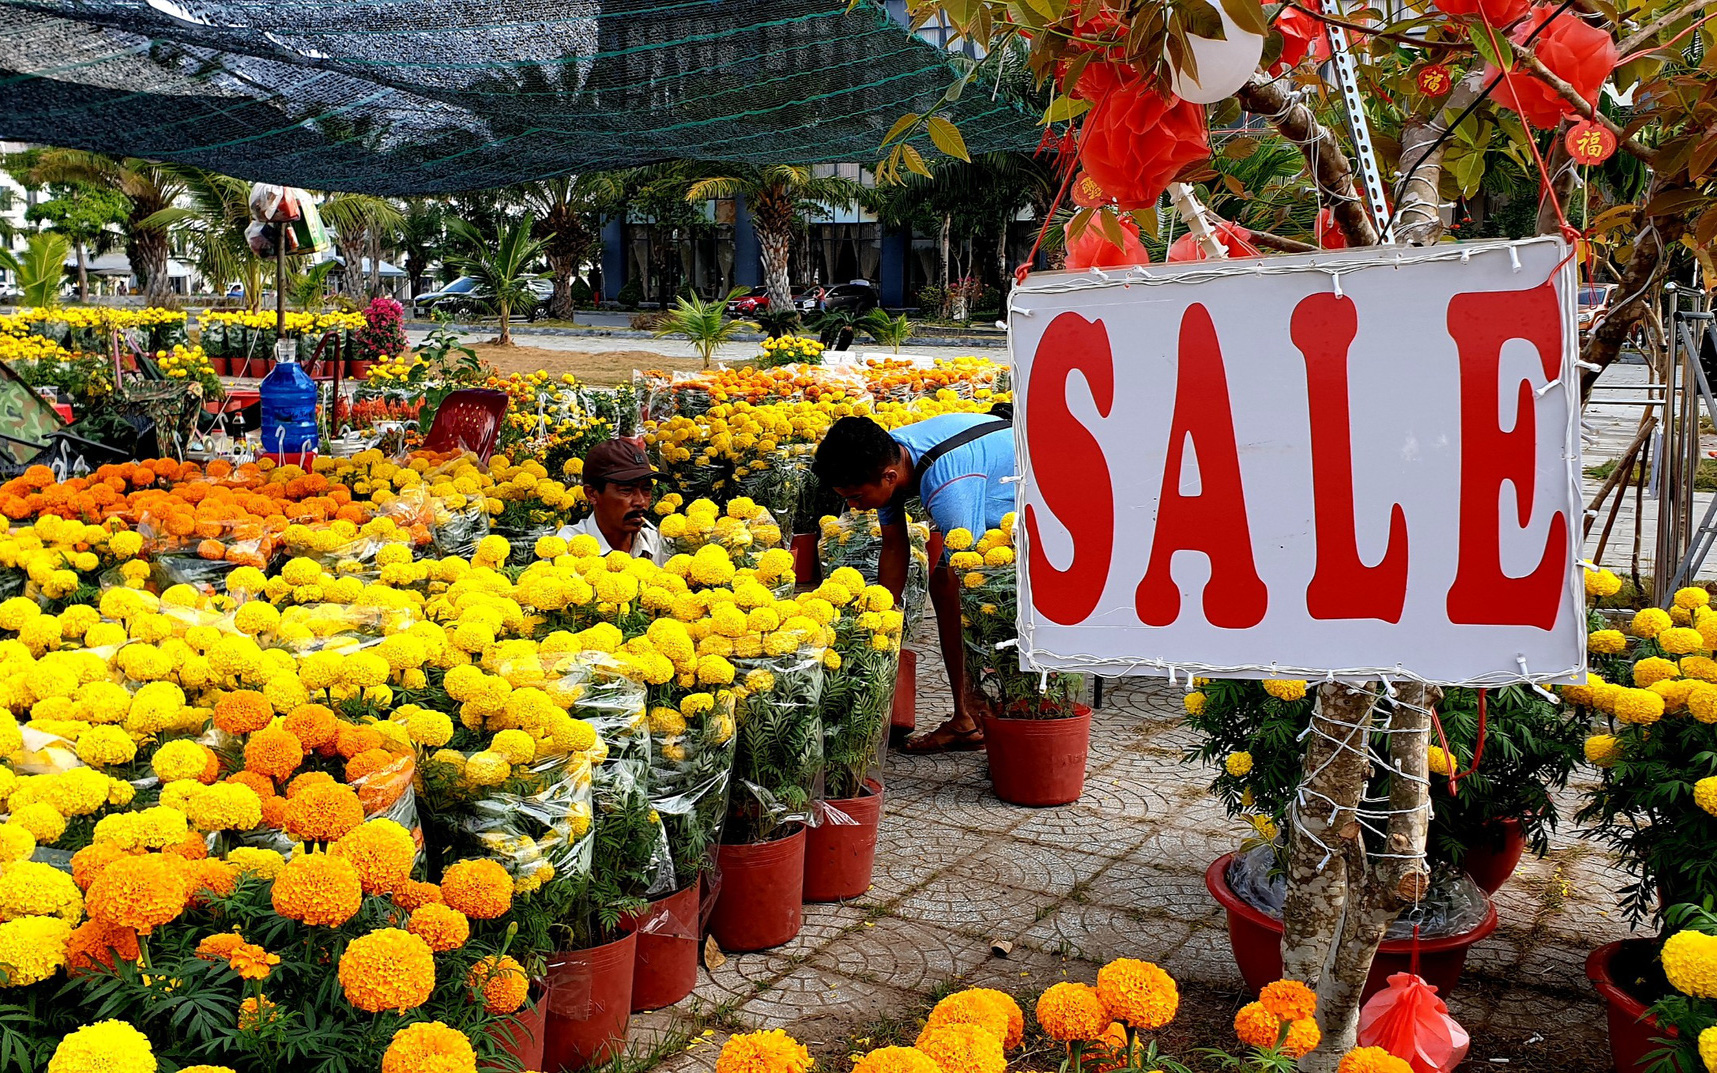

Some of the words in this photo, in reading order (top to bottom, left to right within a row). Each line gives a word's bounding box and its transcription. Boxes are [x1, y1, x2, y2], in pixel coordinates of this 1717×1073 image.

[1423, 70, 1444, 92] 福
[1576, 130, 1603, 157] 福
[1025, 288, 1567, 632] SALE
